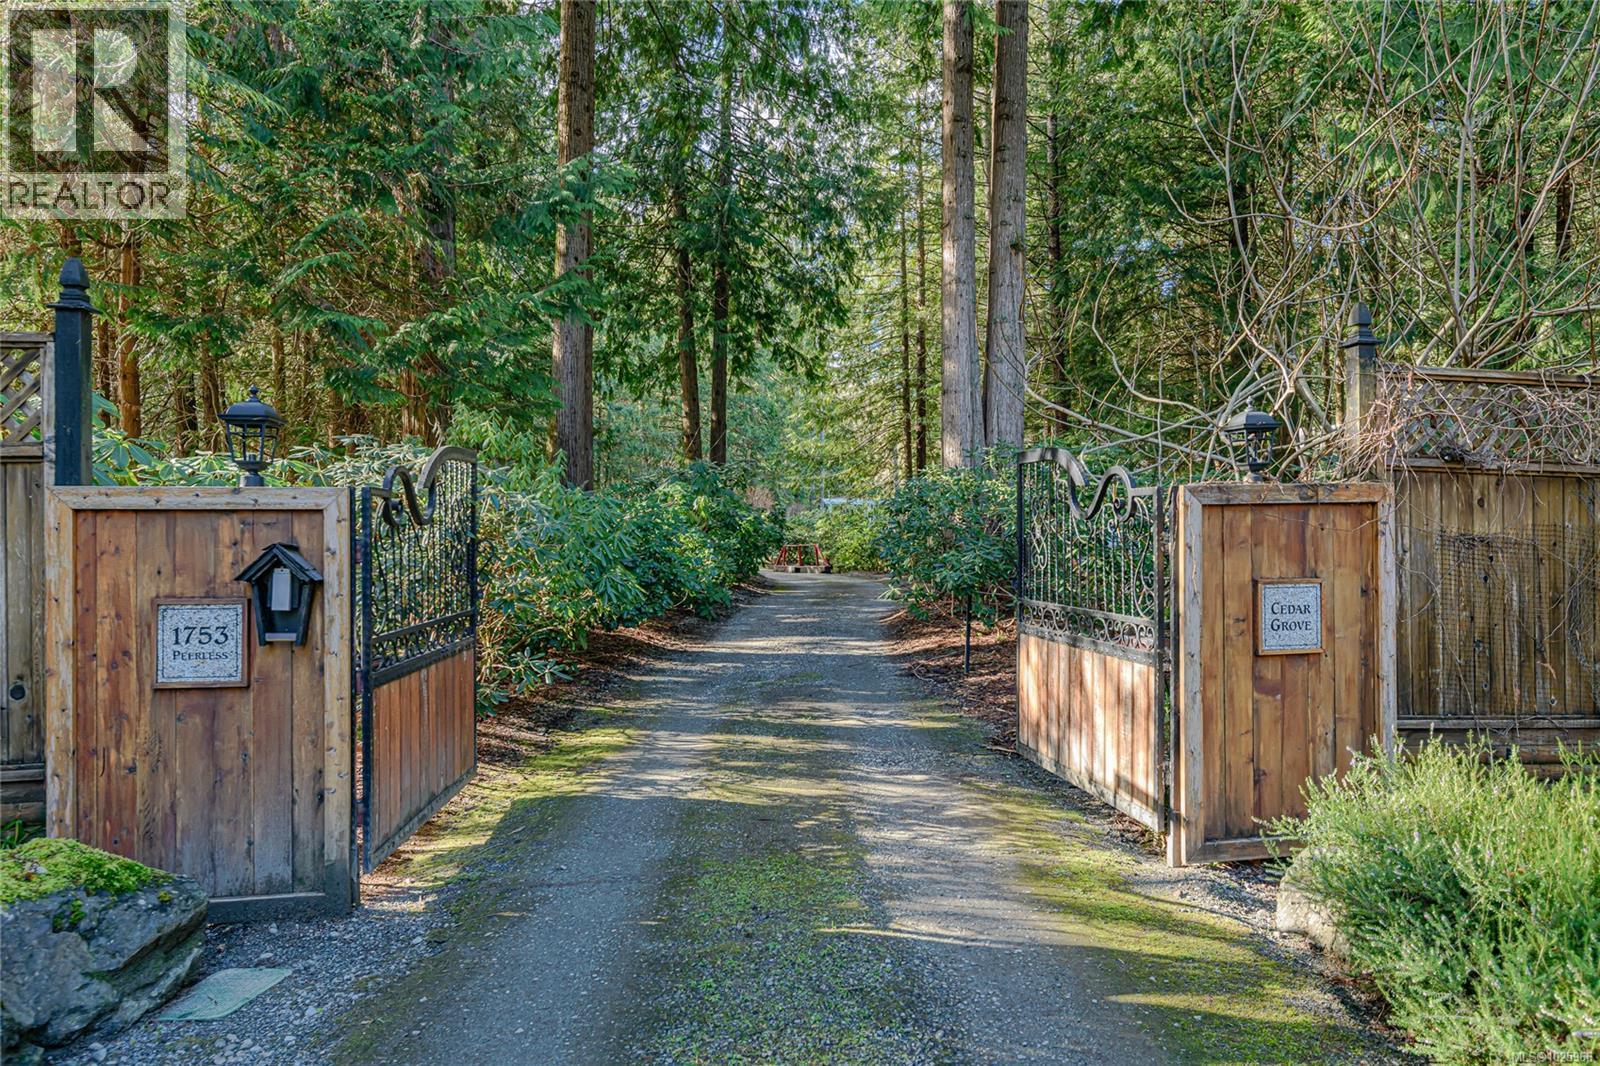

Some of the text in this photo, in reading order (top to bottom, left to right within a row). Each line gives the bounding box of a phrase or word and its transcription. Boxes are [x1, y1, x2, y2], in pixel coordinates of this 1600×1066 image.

[1271, 602, 1311, 615] CEDAR
[1270, 618, 1312, 631] GROVE
[172, 625, 229, 645] 1753
[172, 650, 229, 661] PEERLESS
